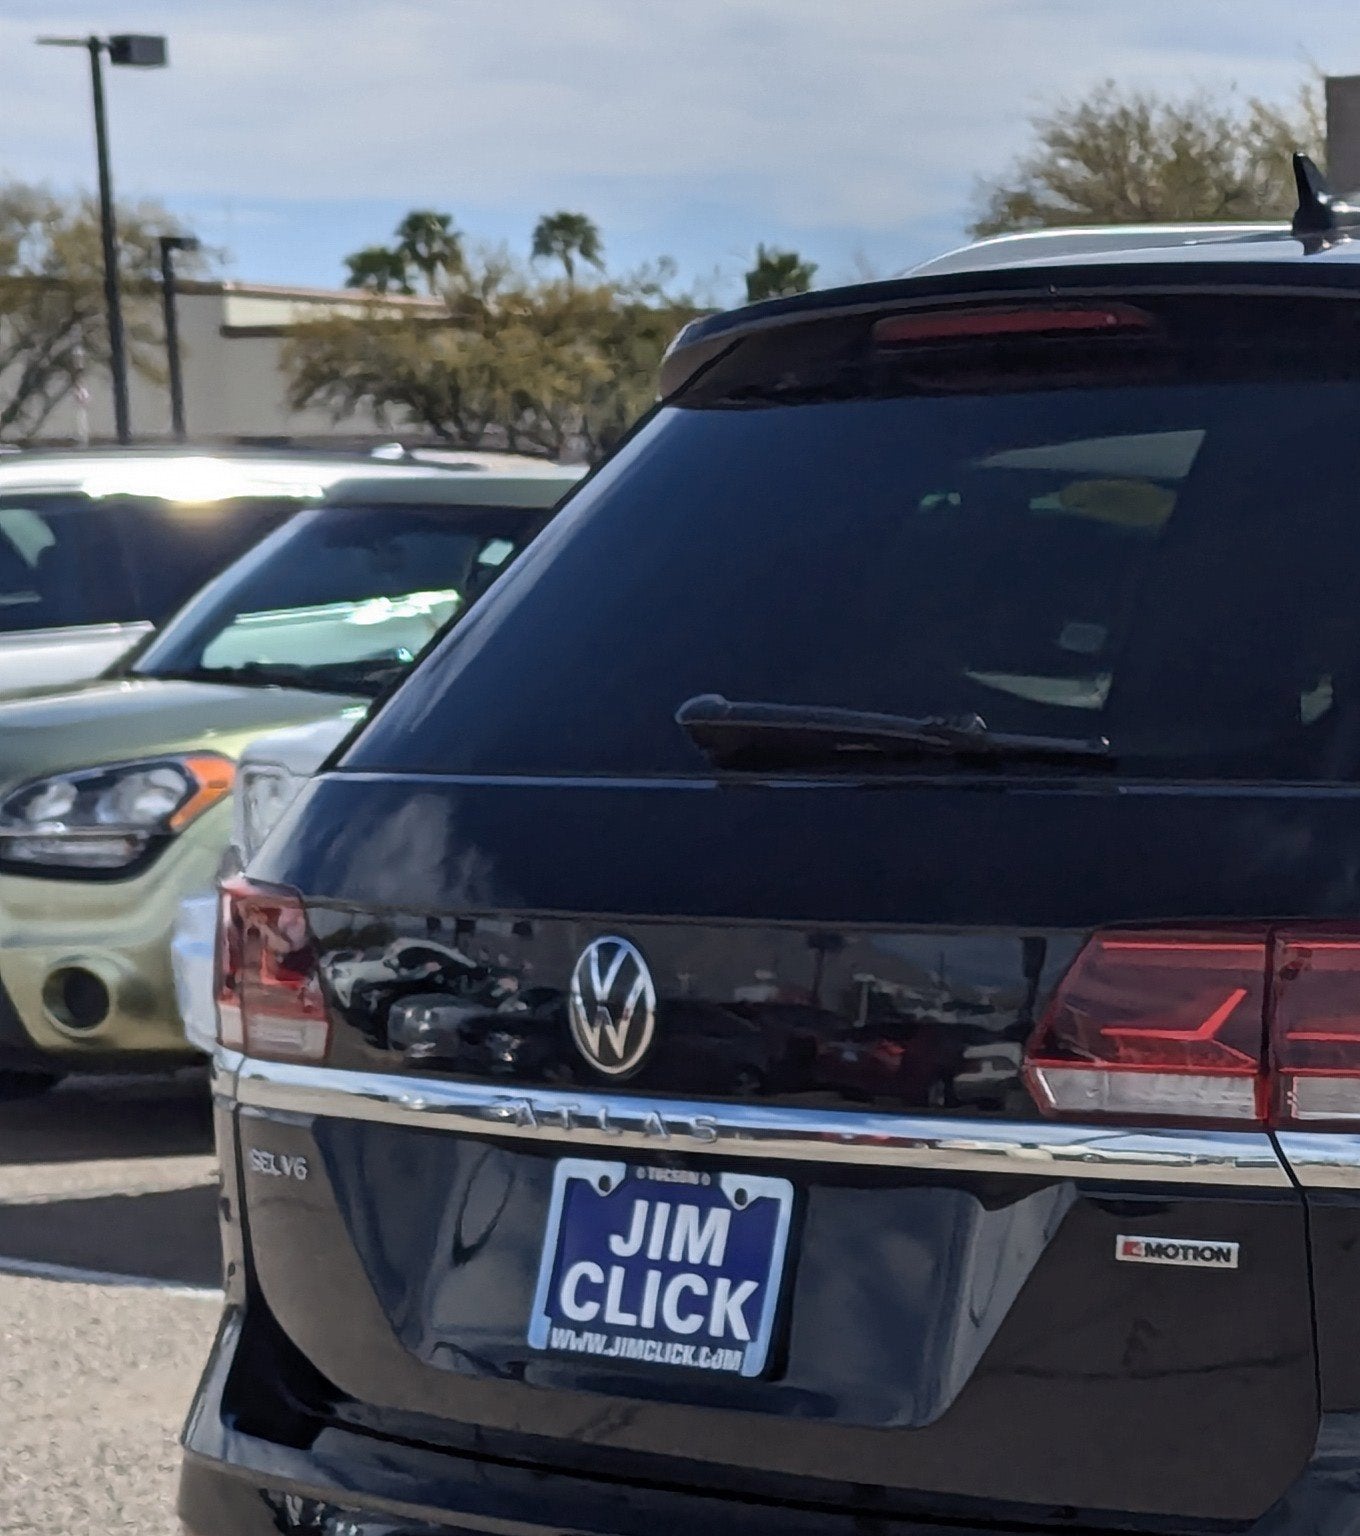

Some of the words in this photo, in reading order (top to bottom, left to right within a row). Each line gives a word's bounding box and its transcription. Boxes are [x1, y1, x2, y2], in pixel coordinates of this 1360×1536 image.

[514, 1098, 719, 1144] ATLAS
[609, 1199, 731, 1267] JIM
[560, 1261, 759, 1341] CLICK
[551, 1327, 743, 1371] WWW.JIMCLICK.COM
